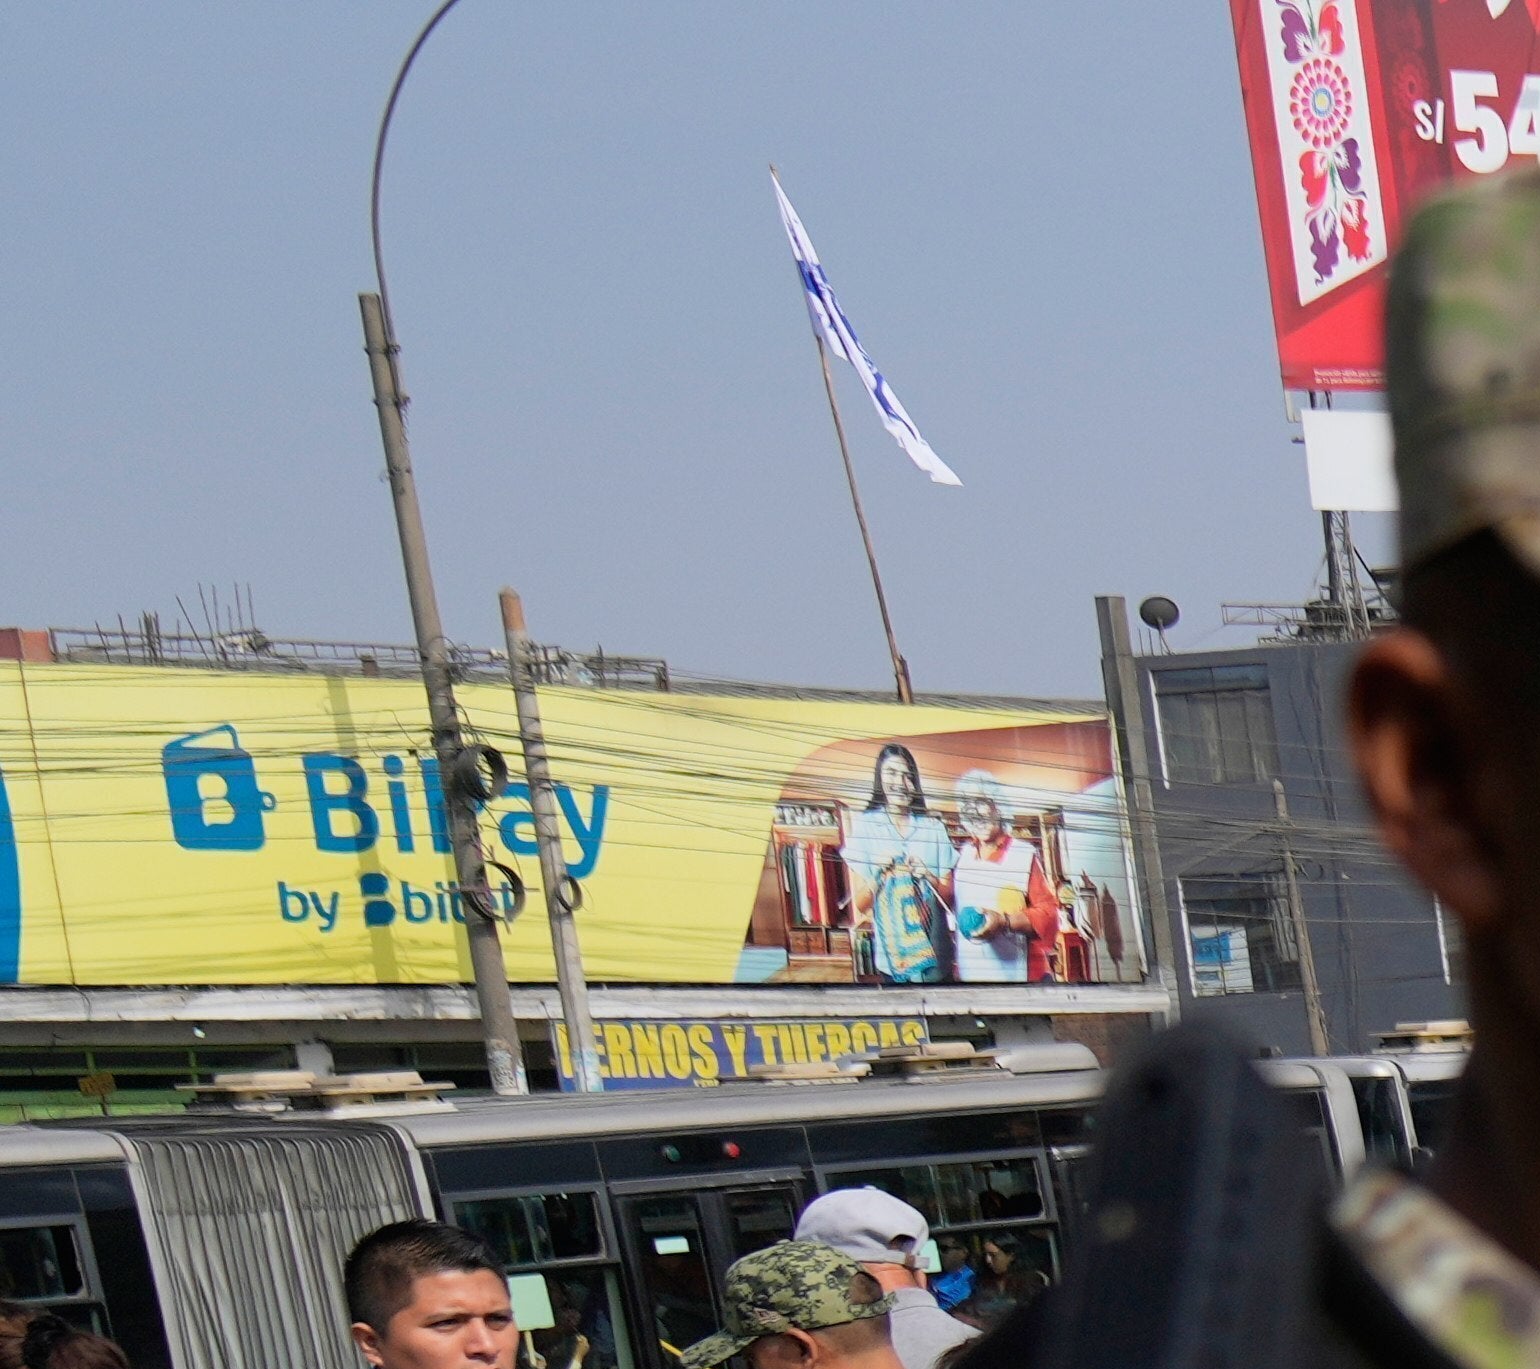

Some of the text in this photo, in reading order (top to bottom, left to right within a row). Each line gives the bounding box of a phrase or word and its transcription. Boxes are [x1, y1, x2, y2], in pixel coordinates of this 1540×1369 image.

[278, 880, 516, 933] by bitl
[721, 1025, 748, 1077] Y
